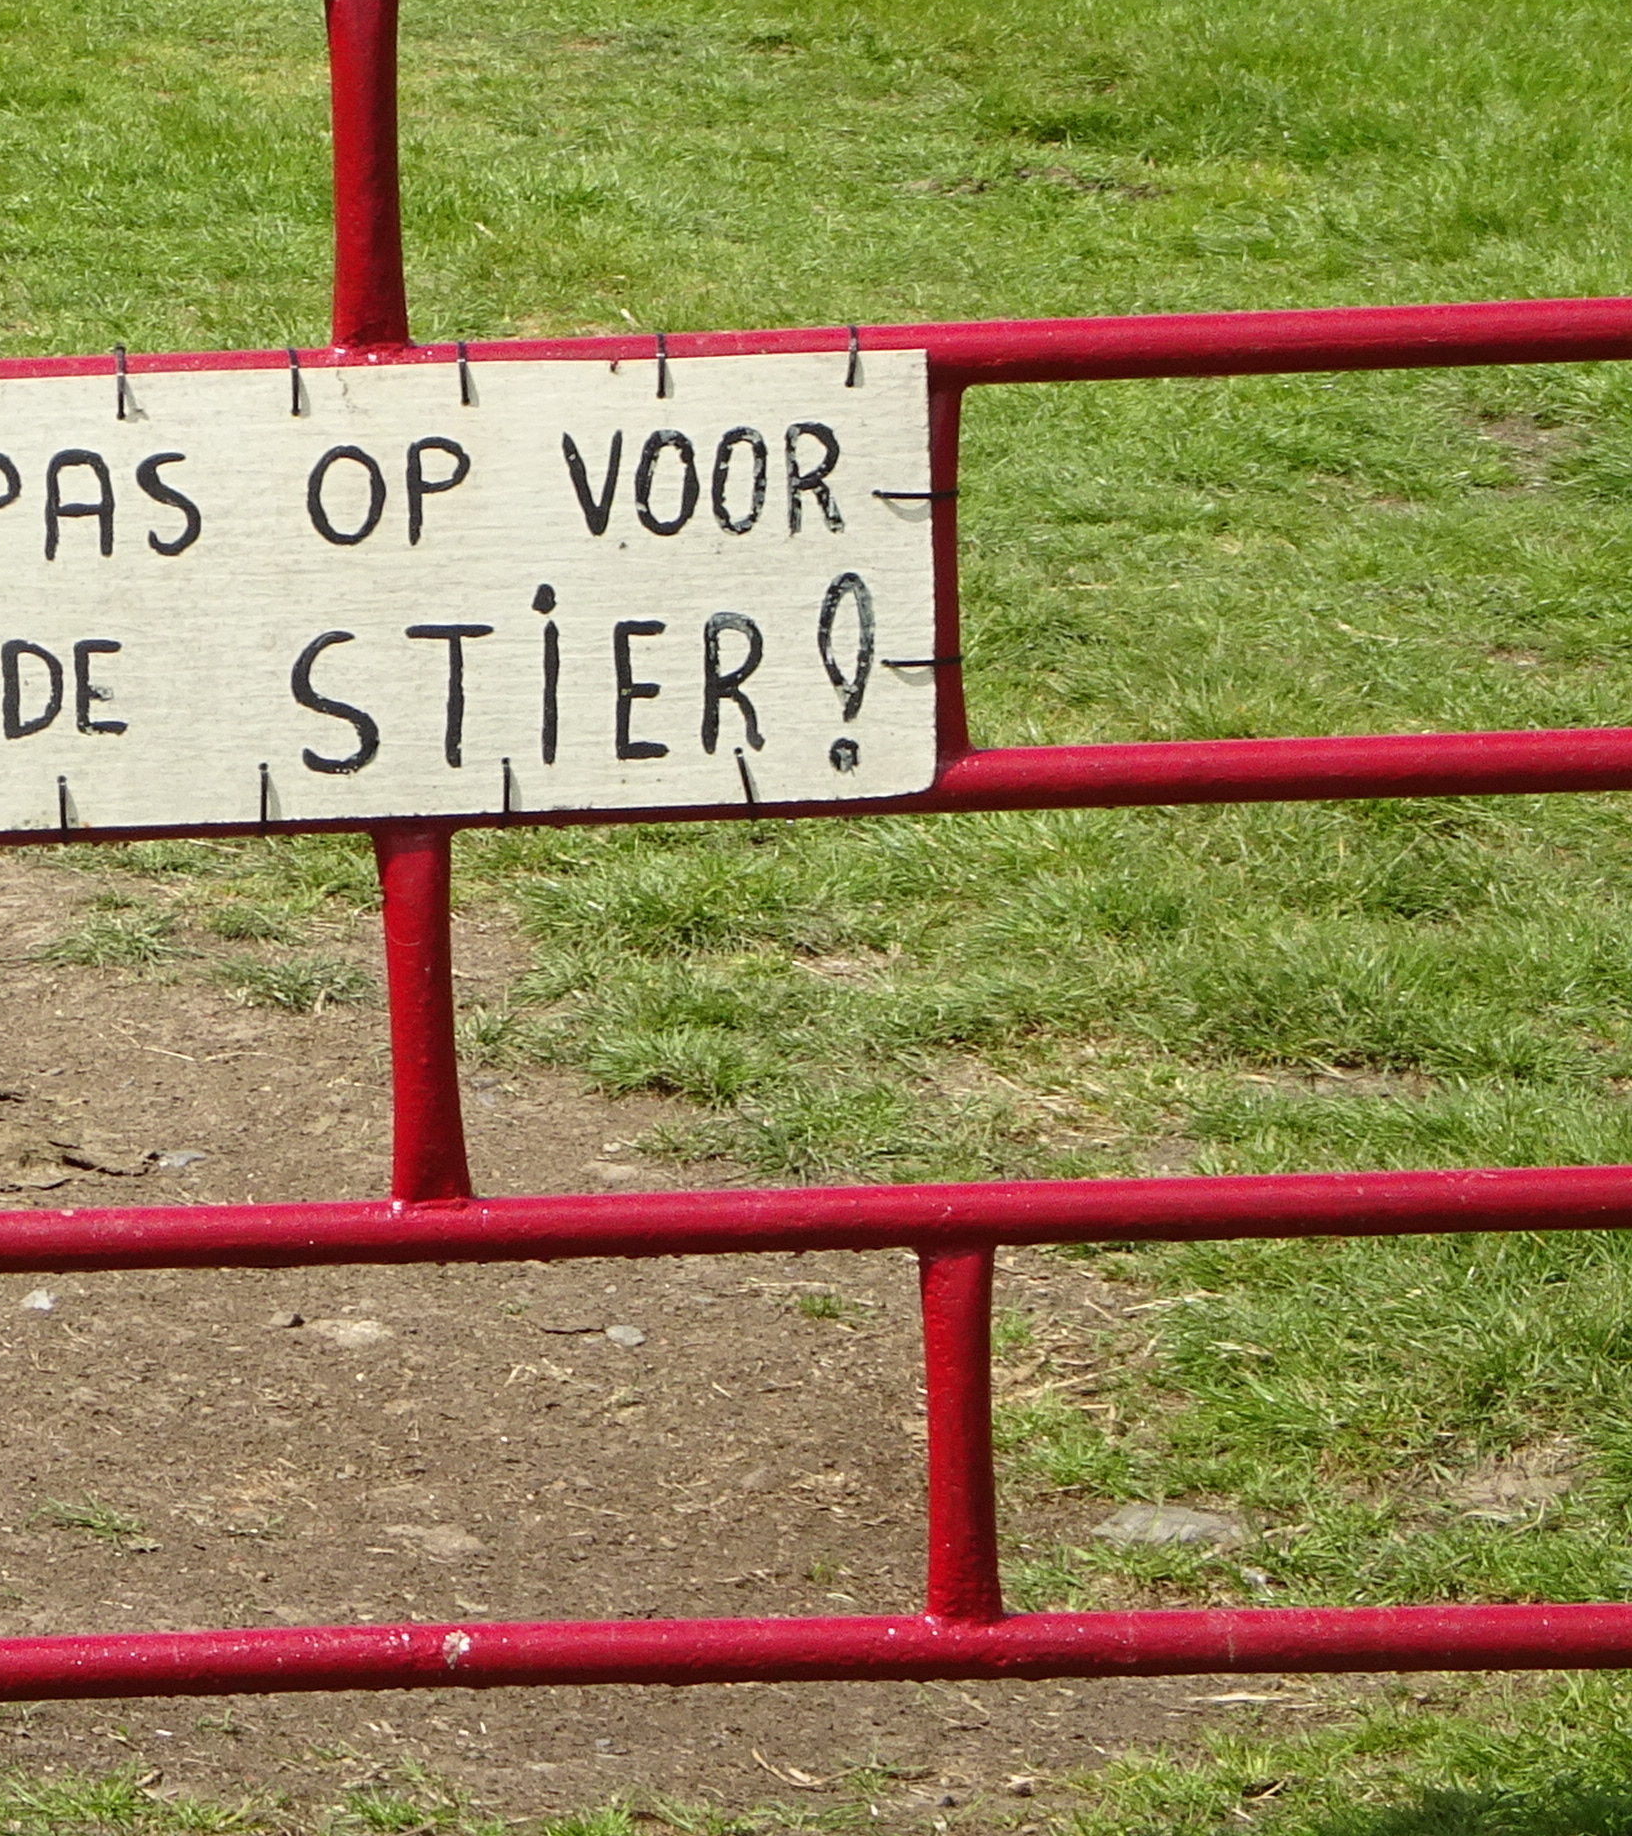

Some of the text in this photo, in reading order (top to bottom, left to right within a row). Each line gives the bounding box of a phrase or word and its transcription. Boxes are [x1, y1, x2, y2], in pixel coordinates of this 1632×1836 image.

[305, 435, 473, 547] OP
[560, 420, 846, 539] VOOR
[0, 637, 130, 741] DE
